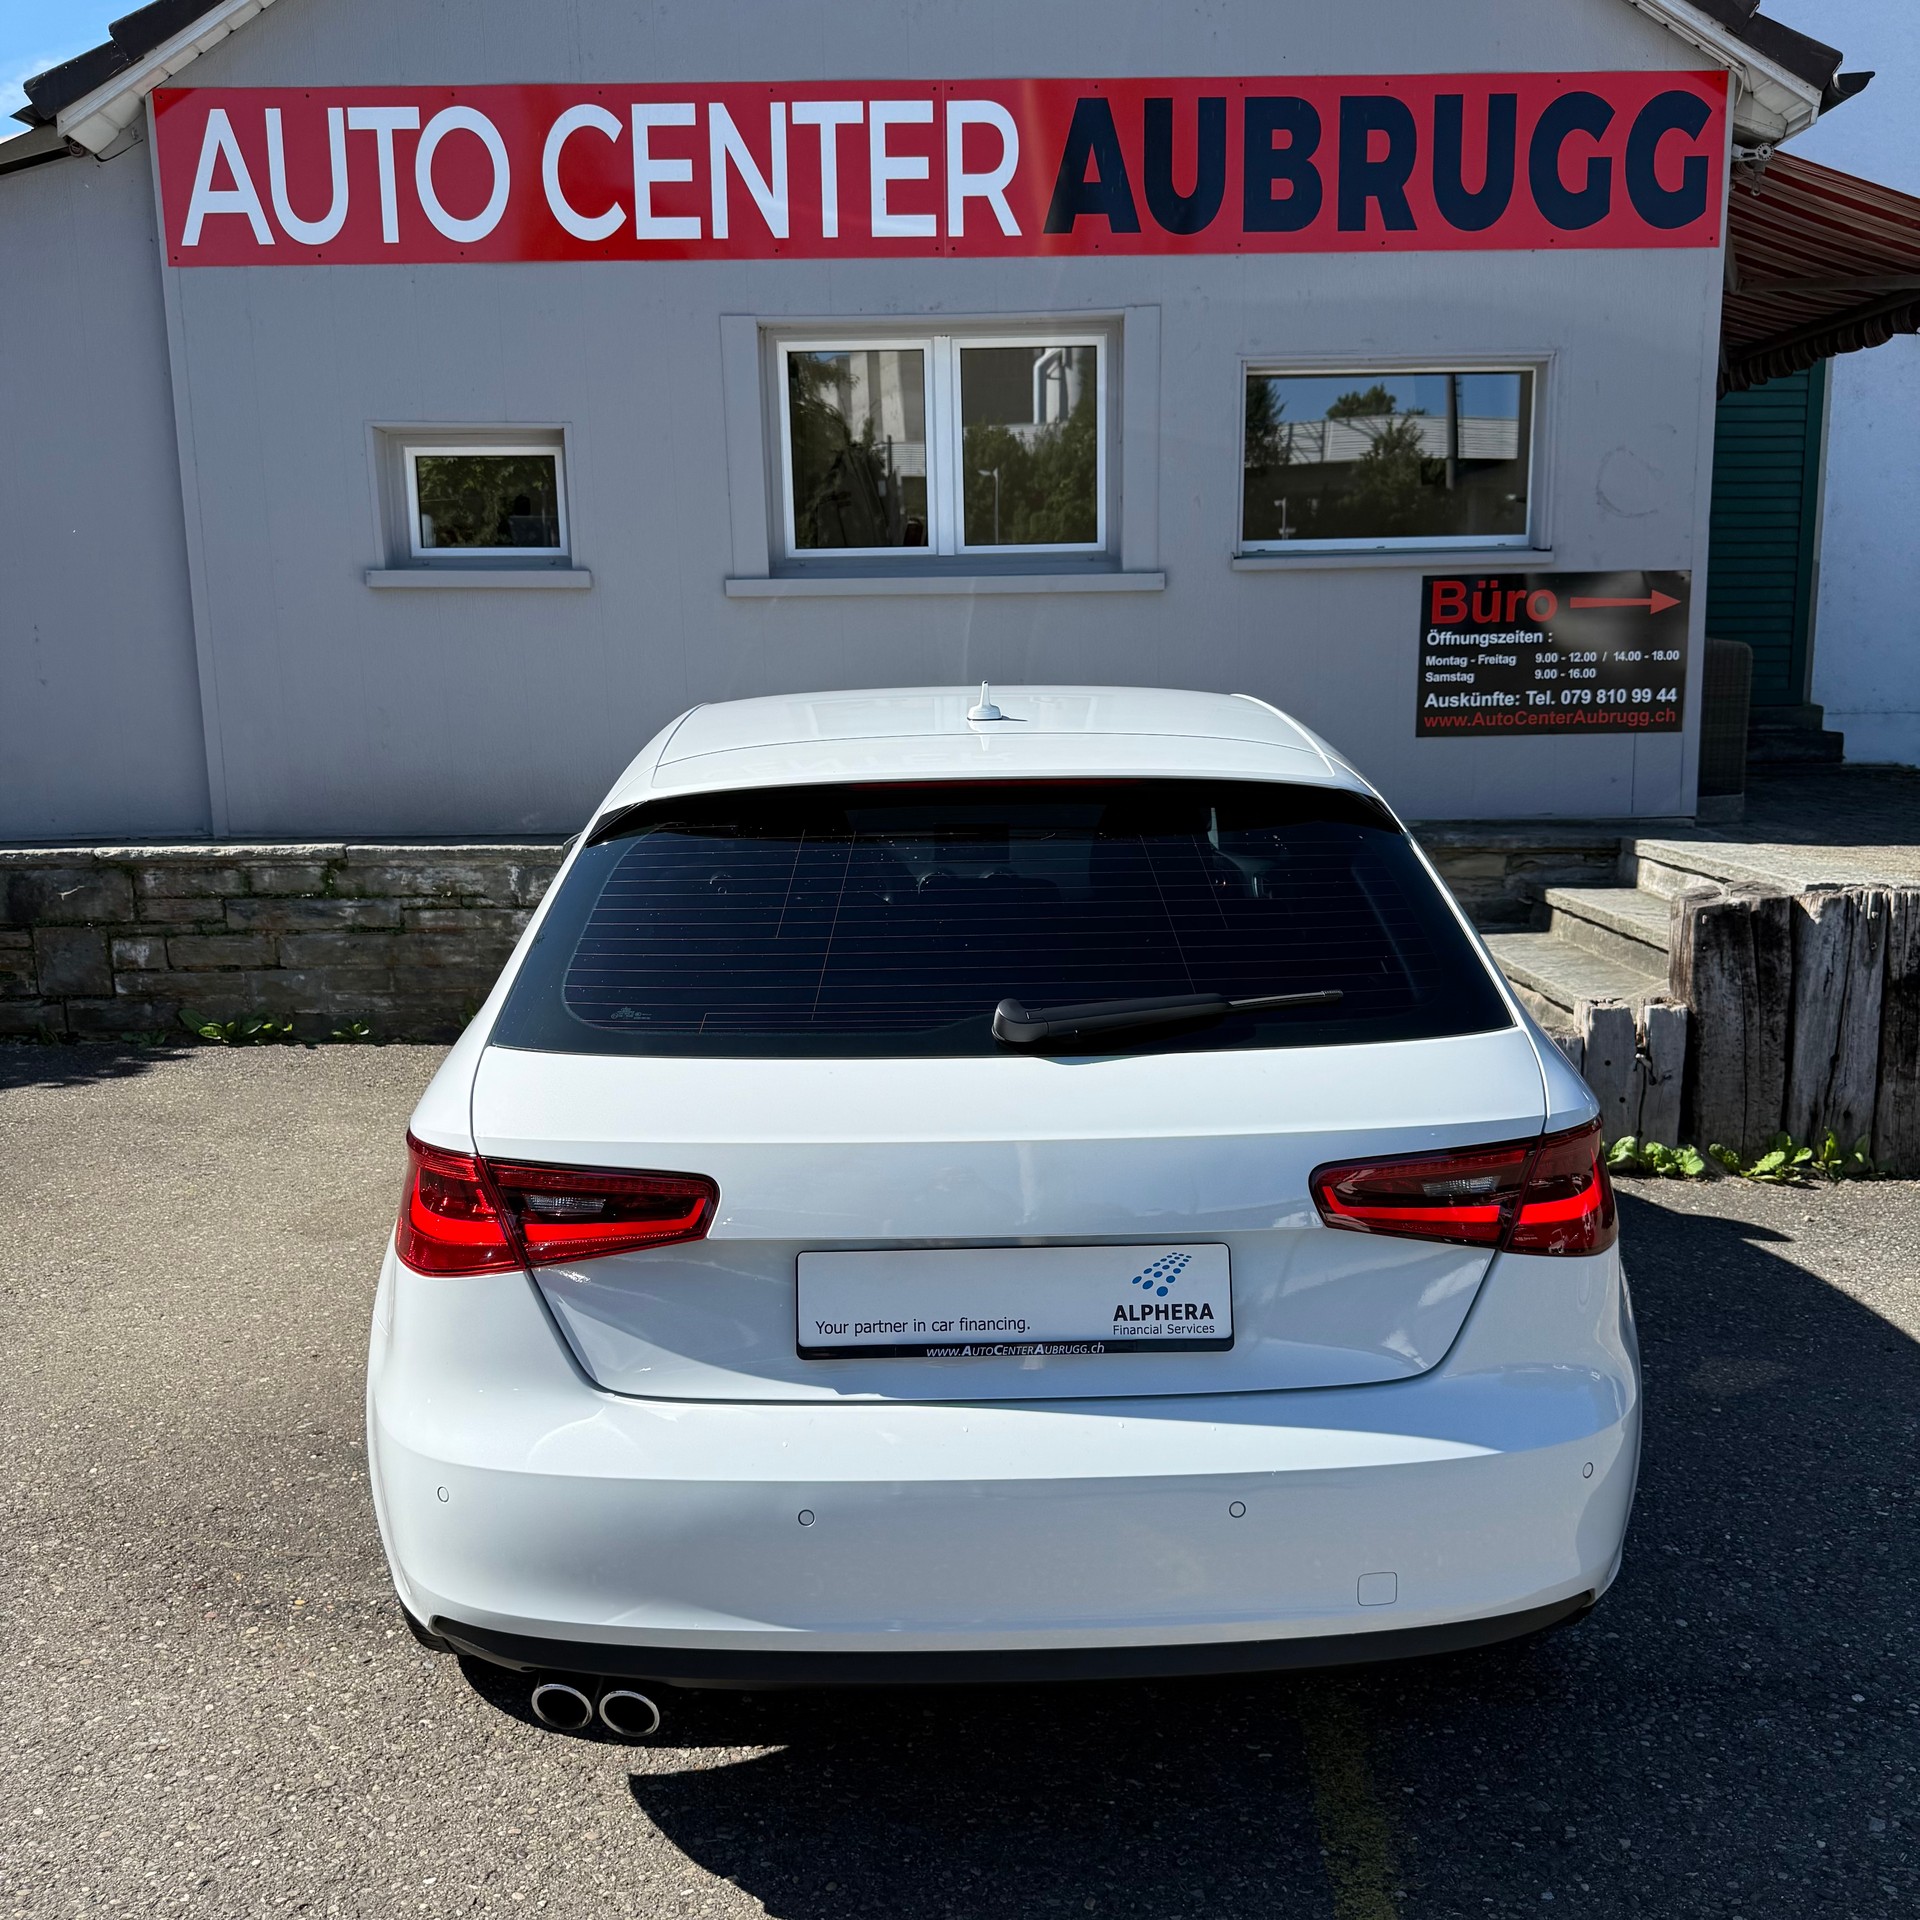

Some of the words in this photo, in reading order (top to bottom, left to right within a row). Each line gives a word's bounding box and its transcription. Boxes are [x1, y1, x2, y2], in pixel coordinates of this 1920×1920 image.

[181, 105, 511, 247] AUTO
[542, 99, 1023, 242] CENTER
[1043, 89, 1713, 235] AUBRUGG
[1431, 580, 1558, 625] Büro
[1426, 629, 1543, 648] Öffnungszeiten
[1425, 654, 1468, 668] Montag
[1478, 653, 1517, 667] Freitag
[1535, 652, 1558, 664] 9.00
[1568, 651, 1597, 663] 12.00
[1613, 651, 1641, 662] 14.00
[1651, 650, 1680, 662] 18.00
[1425, 671, 1475, 684] Samstag
[1534, 669, 1558, 680] 9.00
[1568, 668, 1596, 680] 16.00
[1424, 691, 1521, 708] Auskünfte:
[1526, 690, 1555, 706] Tel.
[1560, 689, 1591, 705] 079
[1596, 689, 1627, 704] 810
[1631, 689, 1651, 703] 99
[1656, 687, 1677, 703] 44
[1424, 707, 1676, 728] www.AutoCenterAubrugg.ch
[1113, 1303, 1215, 1322] ALPHERA
[815, 1320, 849, 1335] Your
[854, 1319, 908, 1337] partner
[913, 1318, 927, 1333] in
[931, 1321, 954, 1332] car
[959, 1316, 1031, 1334] financing.
[1113, 1323, 1162, 1336] Financial
[1167, 1323, 1215, 1335] Services
